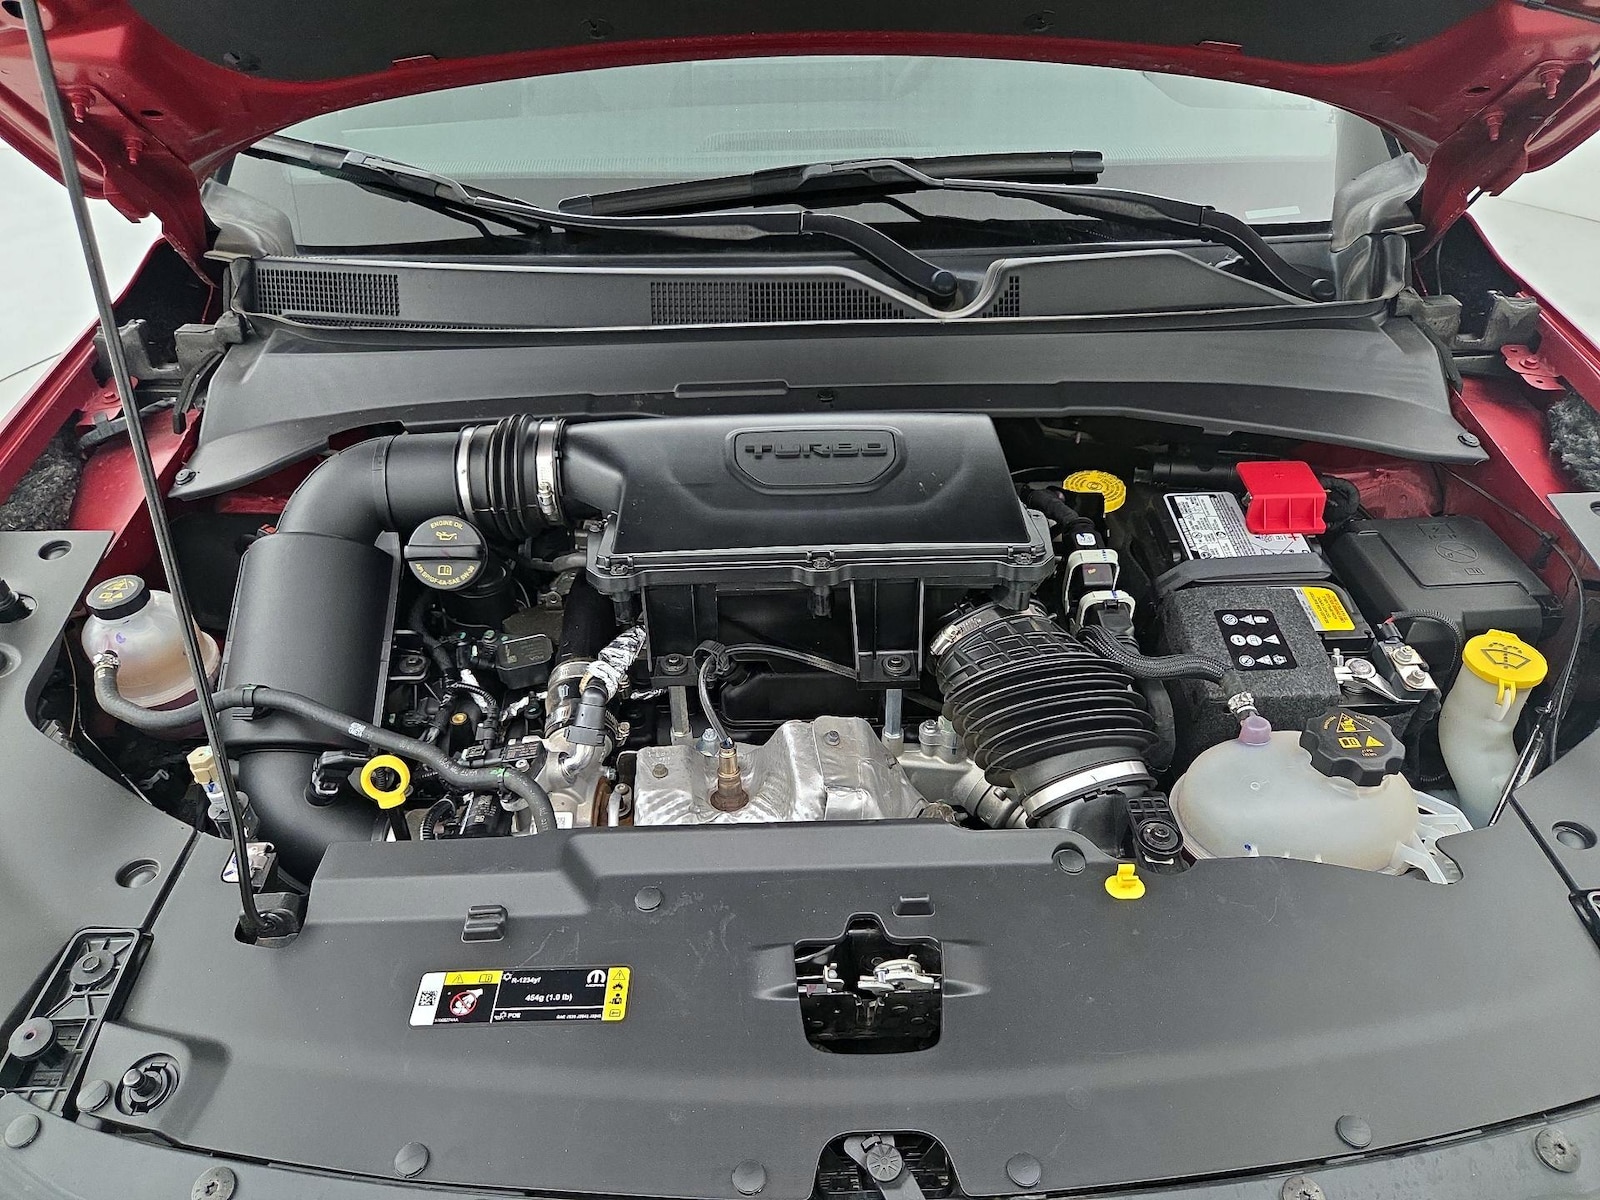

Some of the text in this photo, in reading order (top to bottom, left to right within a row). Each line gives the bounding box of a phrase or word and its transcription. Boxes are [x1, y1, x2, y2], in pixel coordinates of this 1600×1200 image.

[745, 443, 887, 460] TURBO
[430, 520, 464, 530] ENGINE OIL
[415, 563, 424, 573] API
[525, 994, 545, 1003] 454g
[561, 993, 573, 1002] lb)
